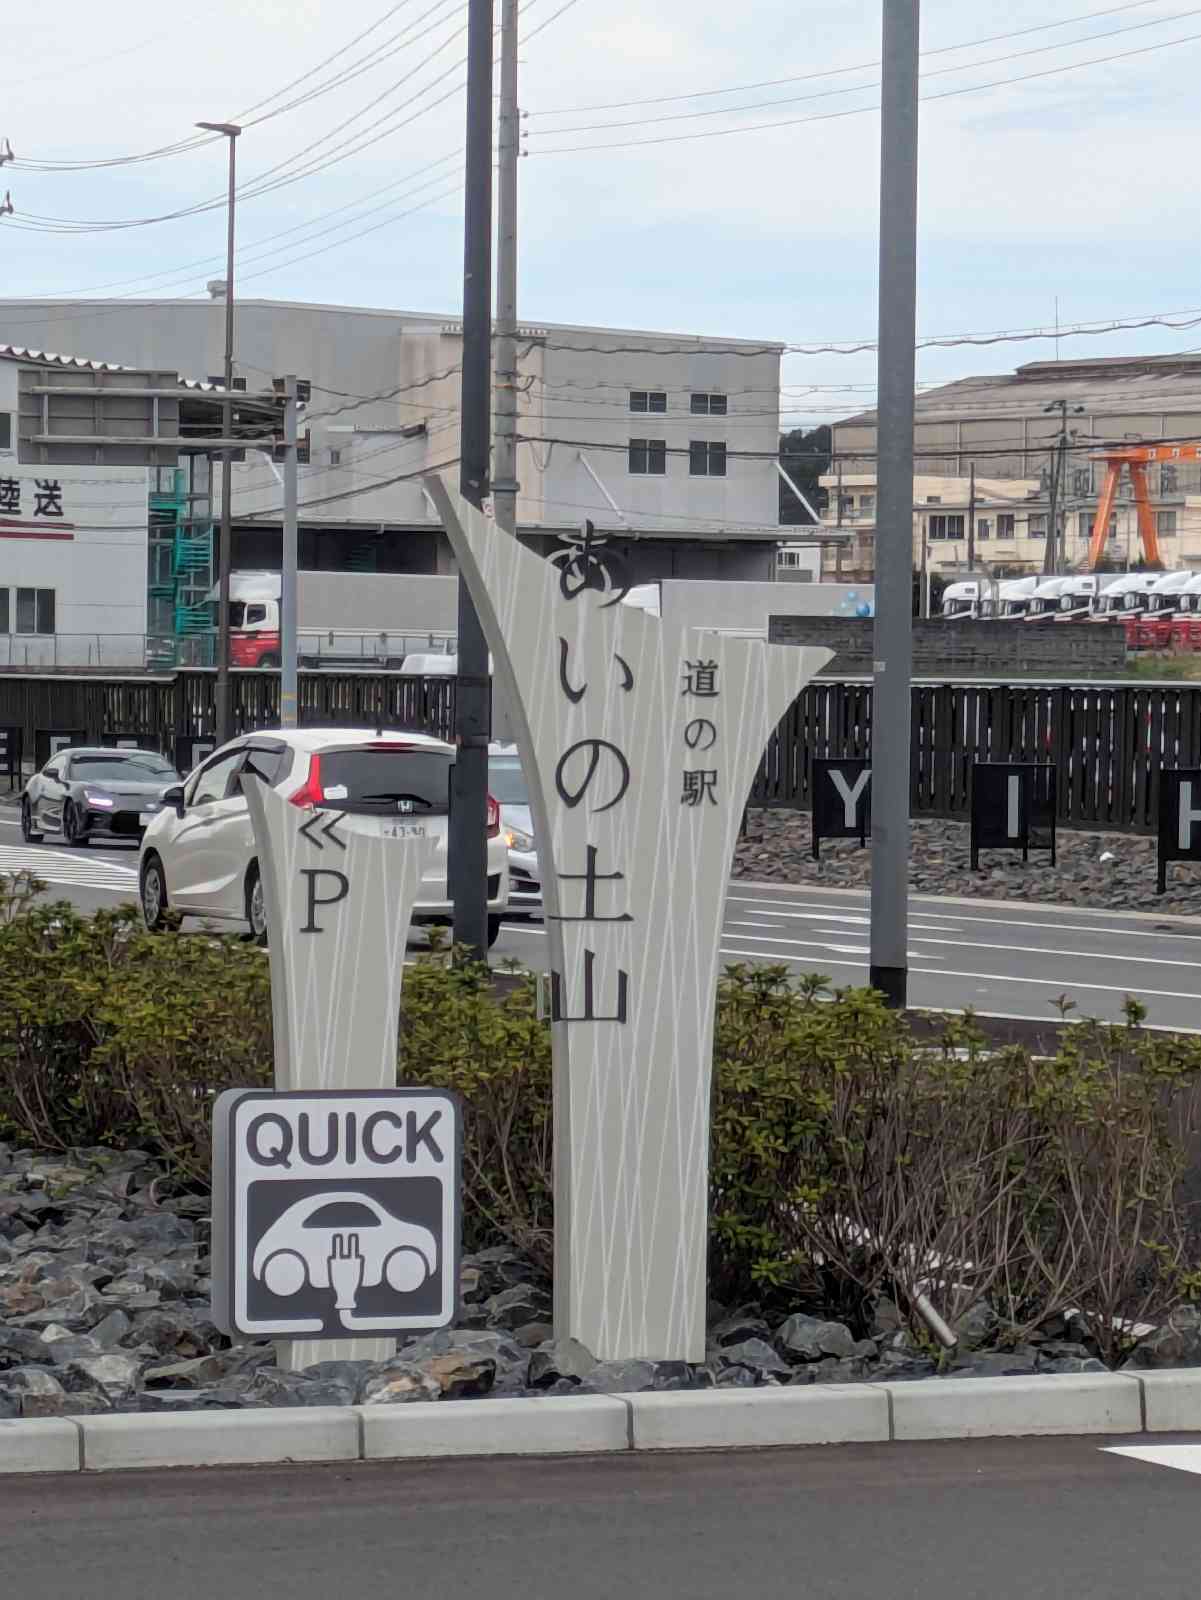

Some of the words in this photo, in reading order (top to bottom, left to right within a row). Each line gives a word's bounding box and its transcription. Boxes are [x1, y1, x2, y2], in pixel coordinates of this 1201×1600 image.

[680, 659, 720, 807] 道の駅
[546, 518, 634, 1025] あいの土山
[828, 769, 872, 828] Y
[300, 868, 349, 933] P
[246, 1110, 444, 1170] QUICK
